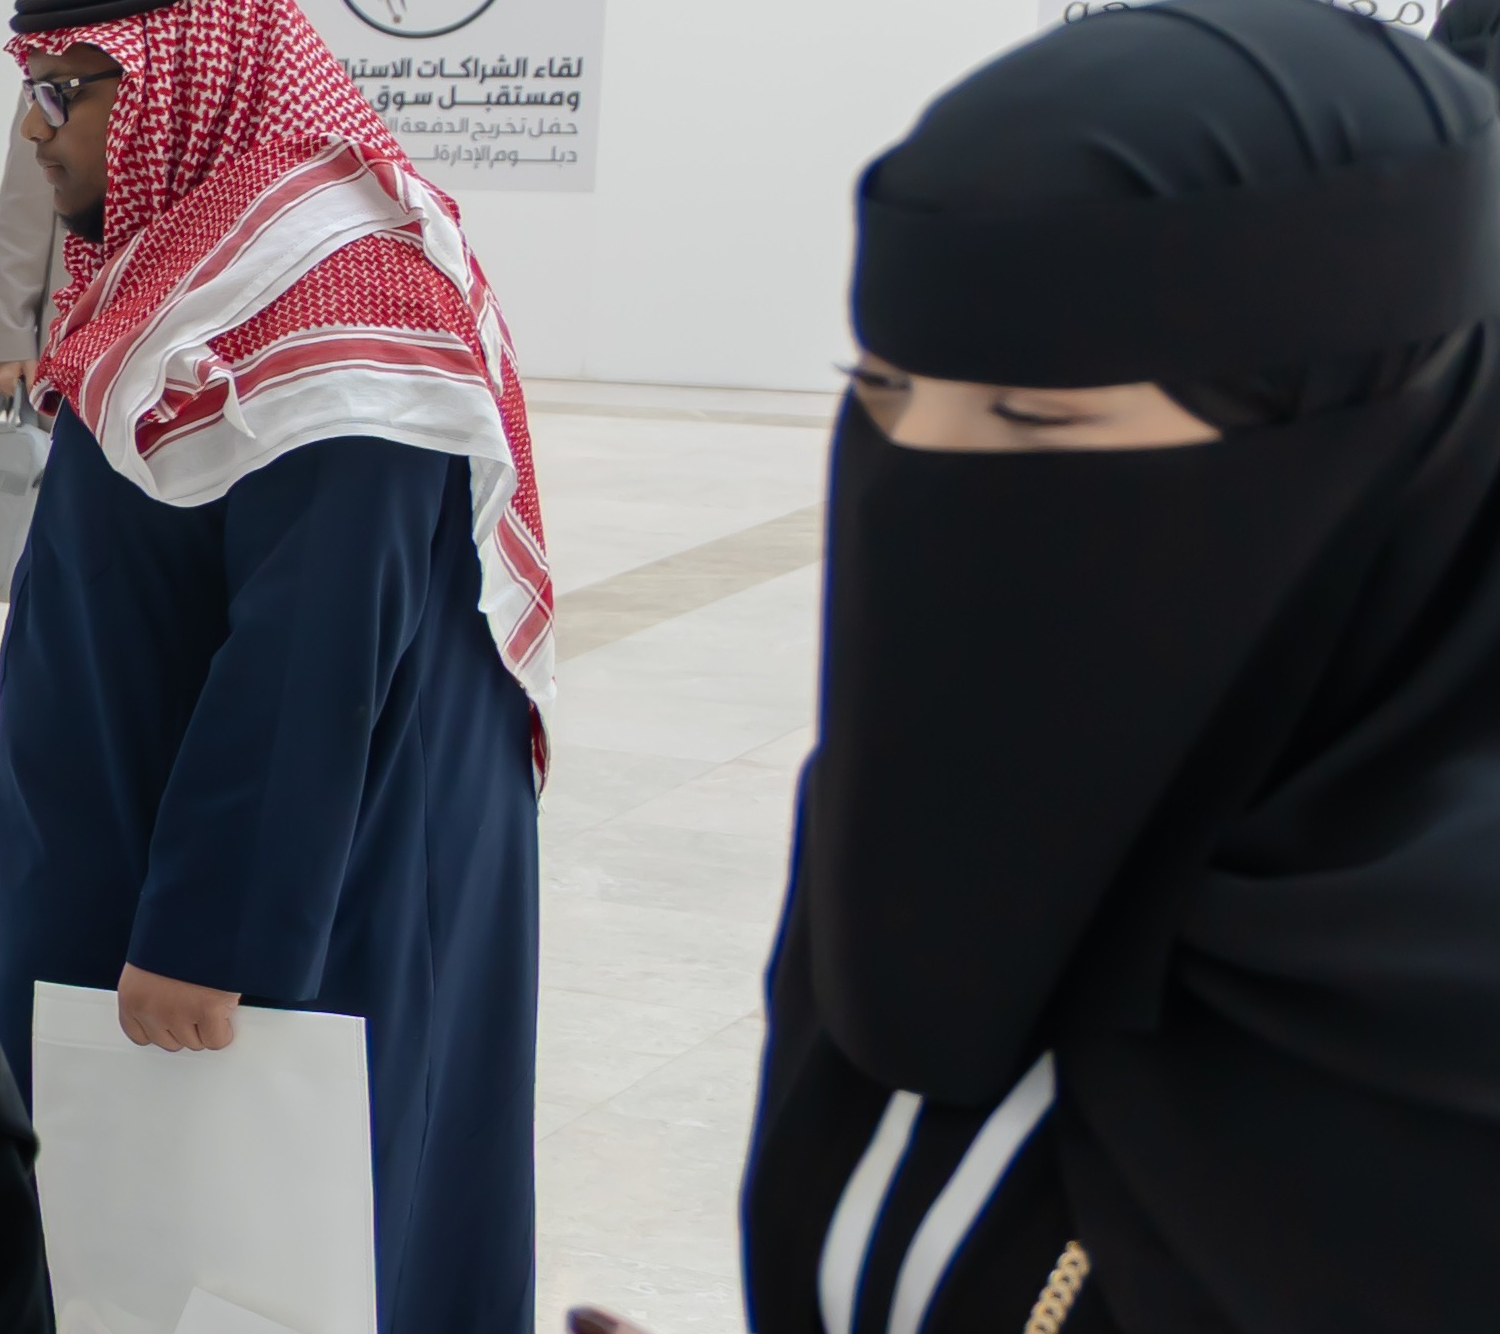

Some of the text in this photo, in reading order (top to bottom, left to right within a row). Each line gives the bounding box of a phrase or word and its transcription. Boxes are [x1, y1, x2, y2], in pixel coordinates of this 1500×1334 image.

[417, 54, 528, 85] الشراكات
[533, 56, 584, 79] لقاء
[370, 84, 581, 113] ومستقبل سوق
[402, 116, 469, 134] الدفعة
[470, 117, 527, 141] تخريج
[528, 117, 579, 138] حفل
[489, 145, 578, 168] دبلوم
